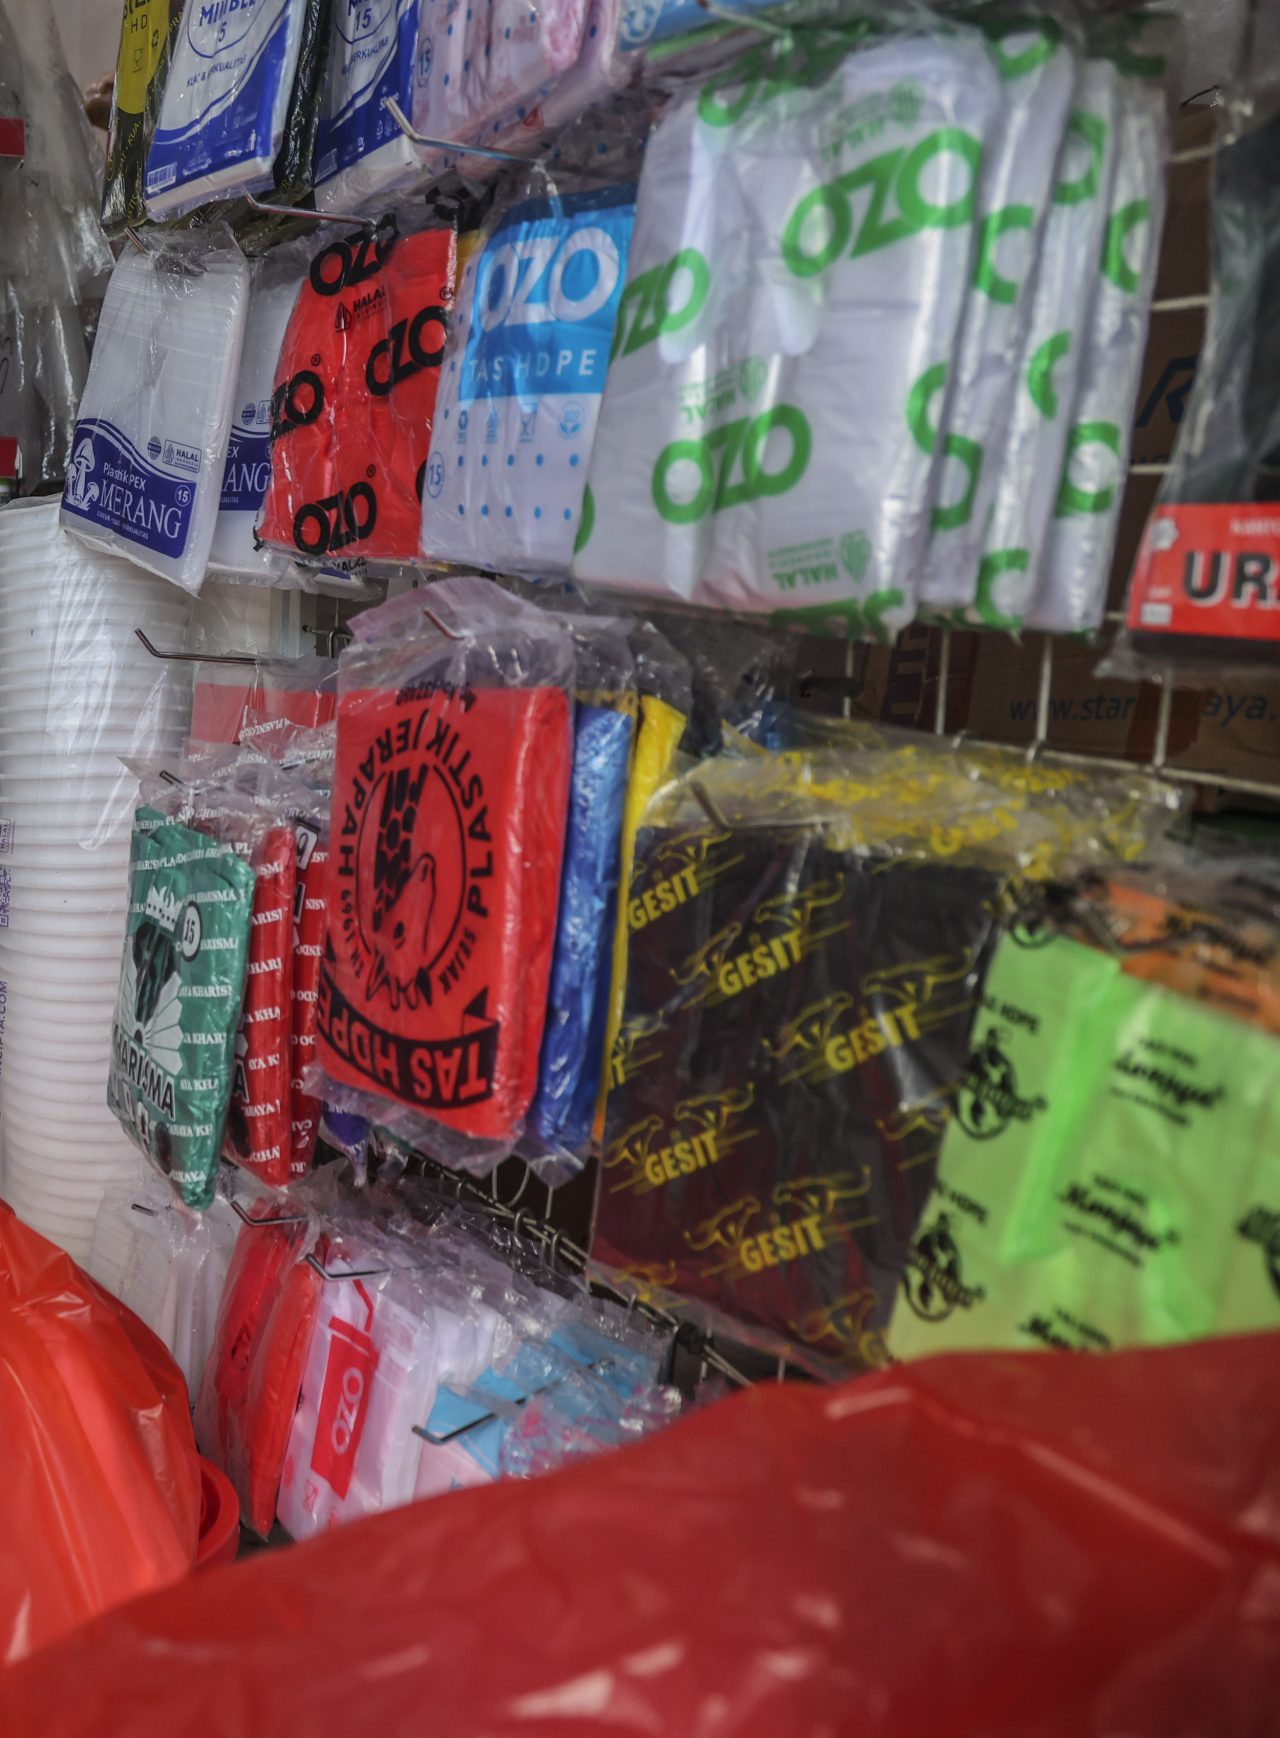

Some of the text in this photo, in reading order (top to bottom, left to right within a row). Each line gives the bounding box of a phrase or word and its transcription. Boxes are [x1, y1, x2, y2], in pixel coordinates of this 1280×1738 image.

[355, 9, 372, 31] 15
[781, 127, 983, 279] OZO
[310, 214, 400, 296] OZO
[479, 227, 619, 332] OZO
[365, 306, 449, 396] OZO
[470, 348, 597, 383] TAS HDPE
[270, 370, 325, 446] ZO
[176, 448, 200, 463] HALAL
[223, 462, 270, 493] ANG
[429, 464, 442, 486] 15
[652, 404, 813, 524] OZO
[99, 479, 183, 539] MERANG
[177, 490, 190, 502] 15
[293, 482, 377, 556] OZO
[1183, 550, 1280, 609] UR
[338, 706, 431, 877] JERAPAH
[425, 718, 494, 920] PLASTIK
[628, 862, 702, 931] GESIT
[184, 921, 197, 946] 15
[441, 925, 479, 995] SEJAK
[719, 930, 803, 997] GESIT
[410, 1036, 493, 1102] TAS
[825, 1002, 921, 1074] GESIT
[113, 1025, 176, 1122] ARISMA
[643, 1128, 720, 1187] GESIT
[738, 1214, 825, 1274] GESIT
[331, 1366, 365, 1456] OZO
